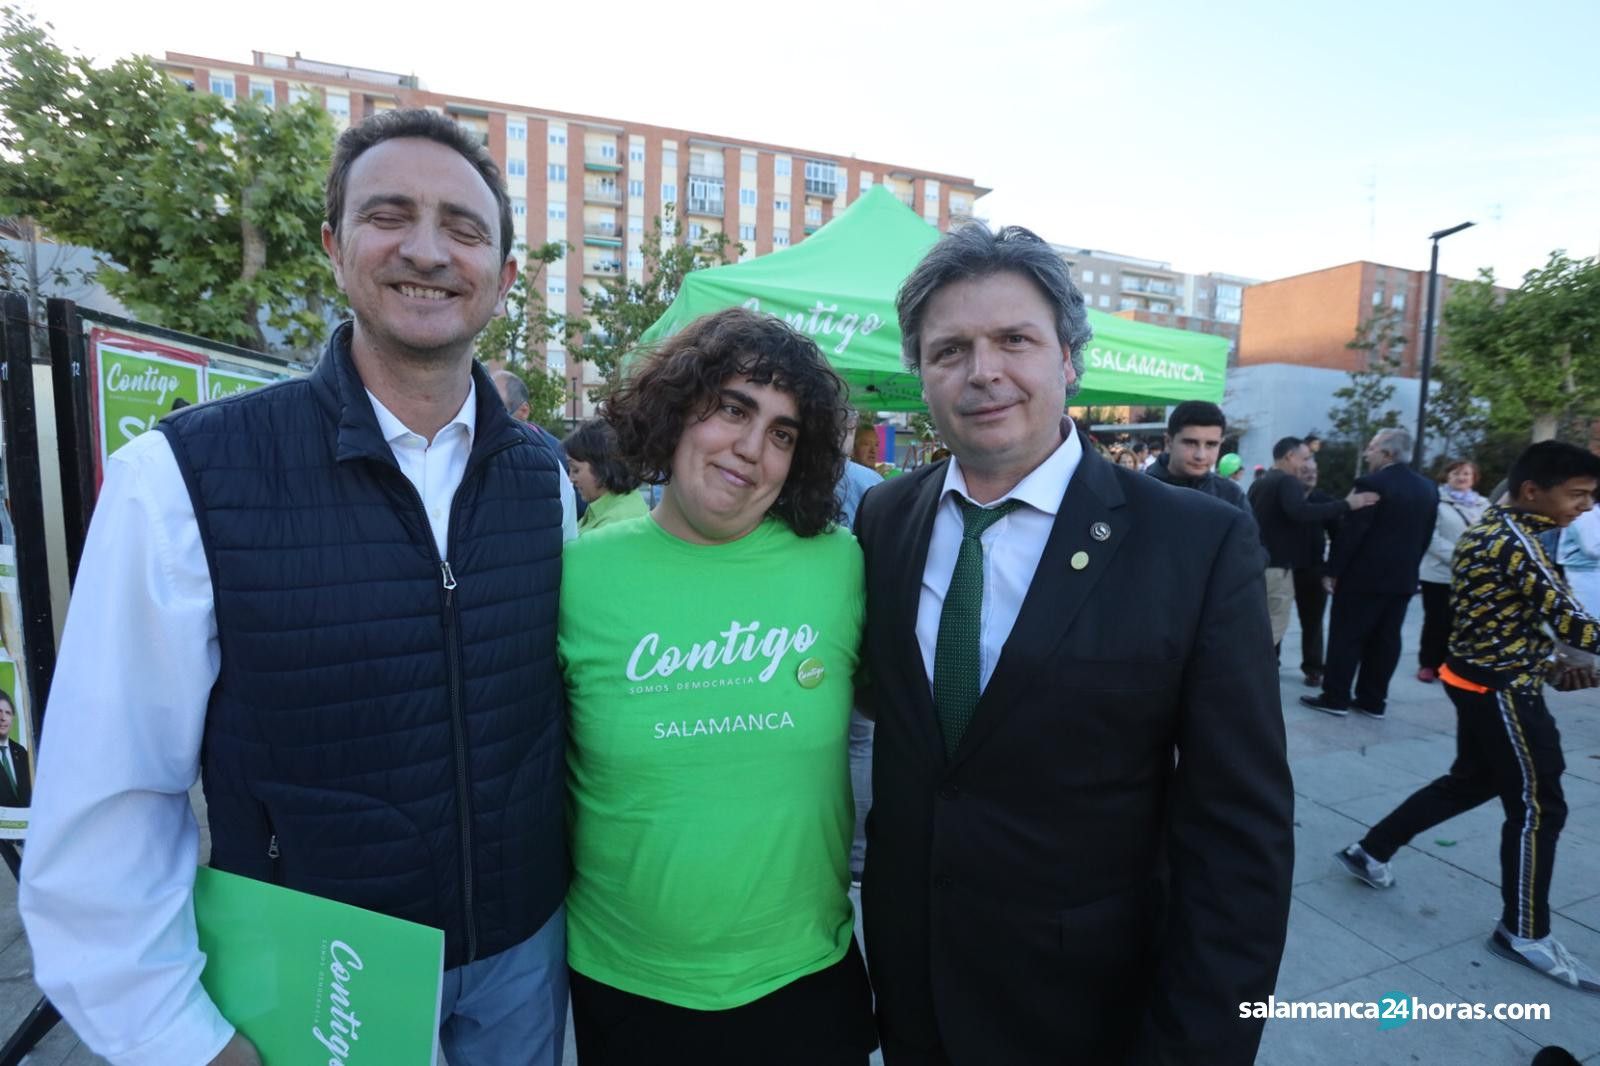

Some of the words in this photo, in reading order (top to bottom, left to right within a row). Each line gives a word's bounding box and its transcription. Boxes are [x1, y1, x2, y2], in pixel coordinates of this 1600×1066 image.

[1090, 348, 1205, 382] SALAMANCA
[106, 362, 180, 405] Contigo
[625, 620, 819, 683] Contigo
[628, 684, 670, 695] SOMOS
[676, 676, 755, 691] DEMOCRACIA
[653, 711, 795, 740] SALAMANCA
